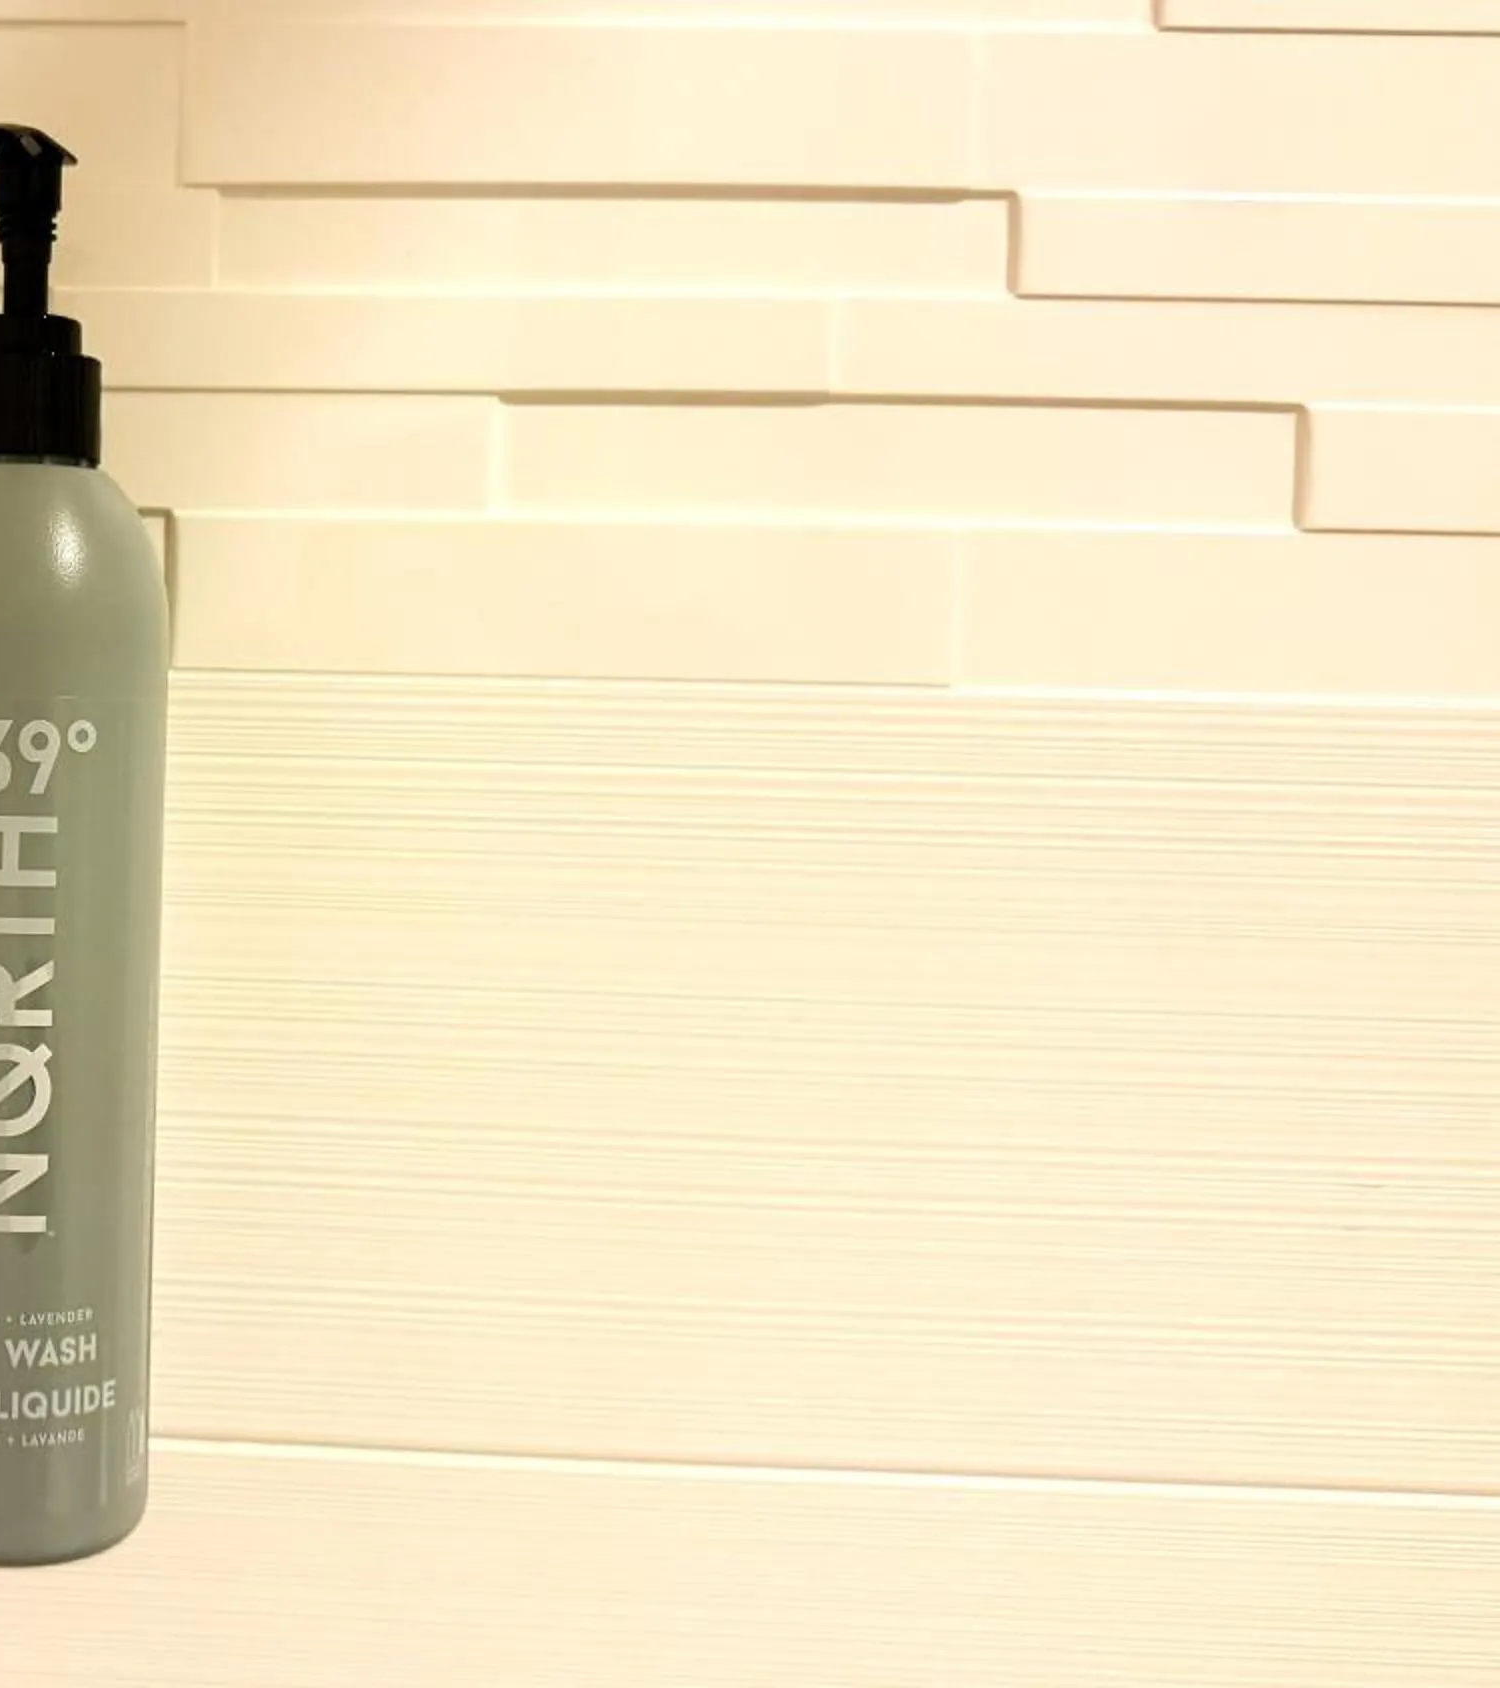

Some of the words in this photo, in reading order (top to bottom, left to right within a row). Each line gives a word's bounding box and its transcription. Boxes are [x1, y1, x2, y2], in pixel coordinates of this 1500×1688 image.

[19, 1308, 93, 1326] LAVENDER
[4, 1332, 97, 1370] WASH
[21, 1427, 85, 1447] LAVANDE
